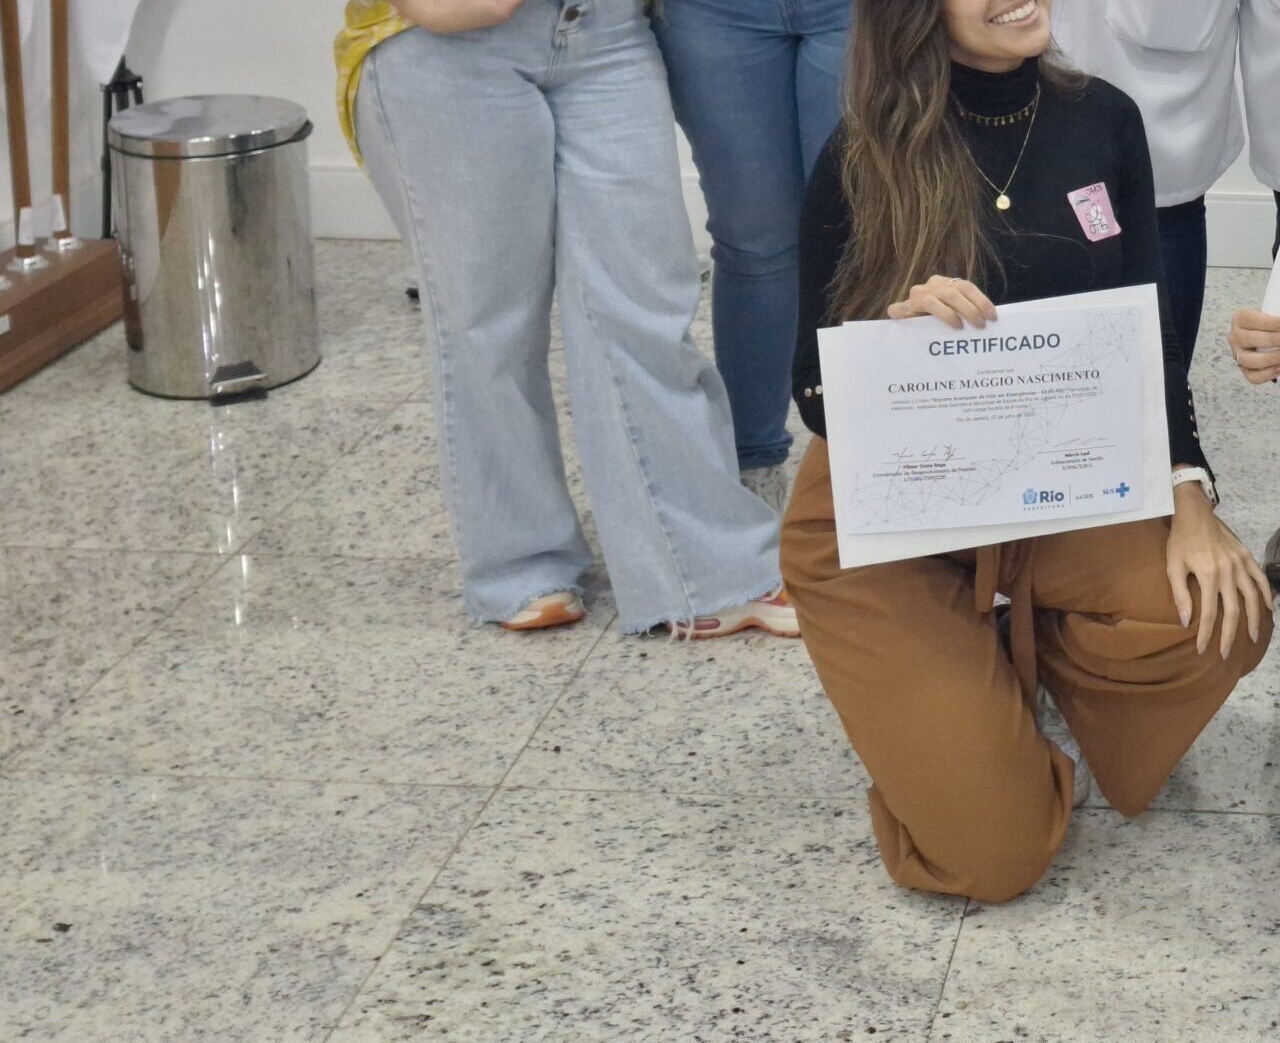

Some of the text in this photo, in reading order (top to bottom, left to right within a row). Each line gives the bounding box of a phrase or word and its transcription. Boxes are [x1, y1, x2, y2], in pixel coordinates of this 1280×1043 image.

[928, 333, 1061, 357] CERTIFICADO
[888, 369, 1101, 394] CAROLINE MAGGIO NASCIMENTO
[1039, 490, 1065, 503] Rio
